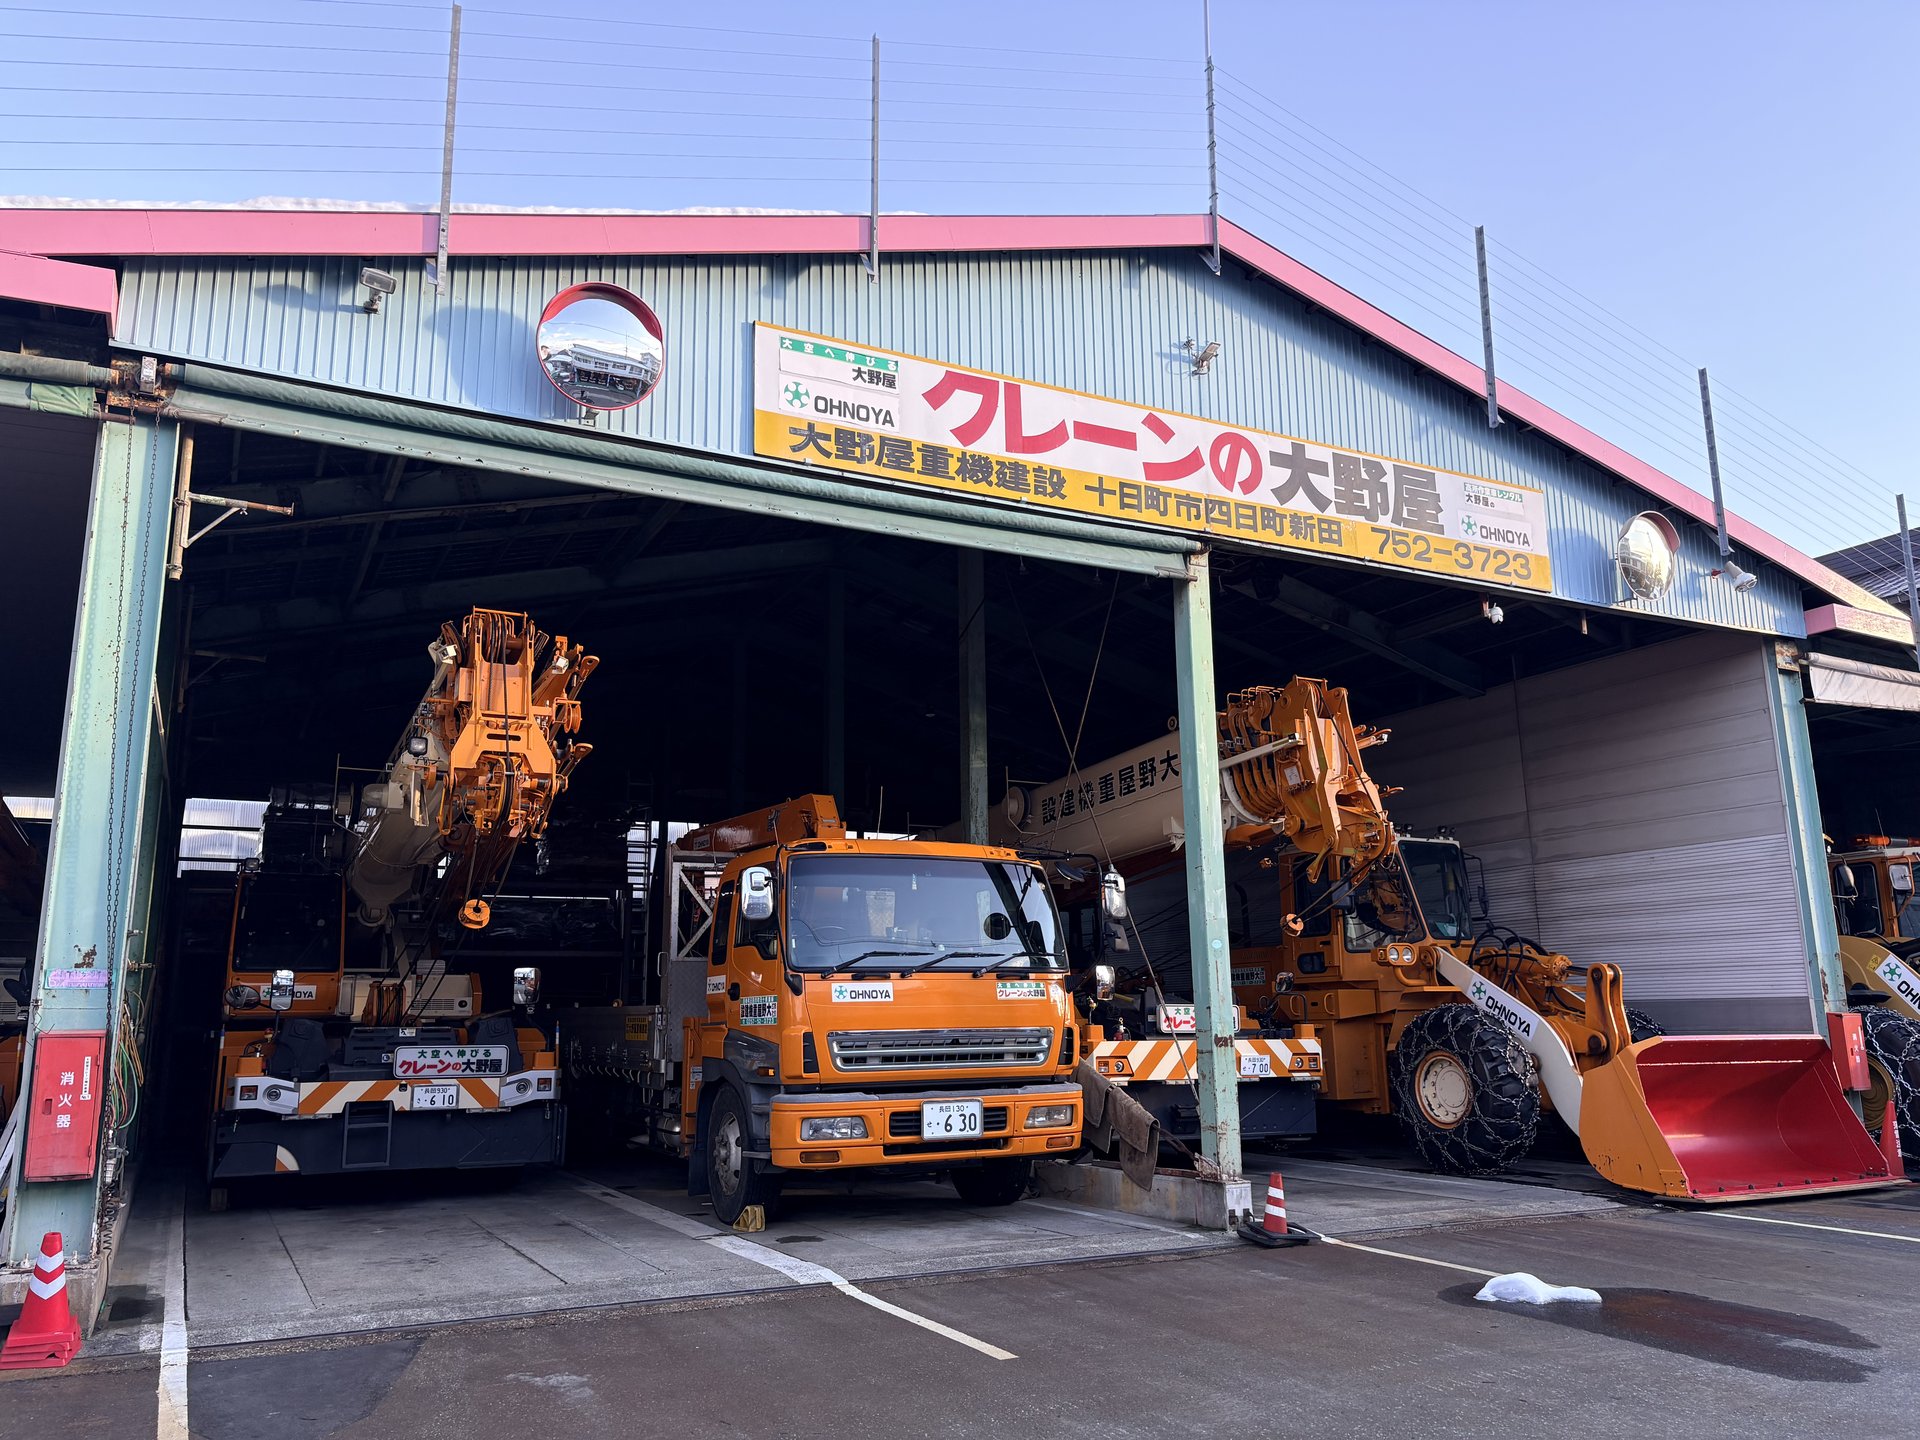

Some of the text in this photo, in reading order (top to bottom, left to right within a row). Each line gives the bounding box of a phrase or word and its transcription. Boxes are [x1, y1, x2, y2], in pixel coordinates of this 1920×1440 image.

[782, 338, 897, 371] 大空へ伸びる
[852, 366, 897, 390] 大野屋
[814, 395, 895, 428] OHNOYA
[922, 369, 1445, 535] クレーンの大野屋
[788, 421, 1533, 581] 大野屋重機建設 十日町市四日町新田 752-3723
[1480, 525, 1531, 547] OHNOYA
[849, 989, 892, 1000] OHNOYA
[1485, 995, 1532, 1037] OHNOYA
[399, 1059, 503, 1075] クレーンの大野屋
[417, 1049, 492, 1059] 大空へ伸びる
[56, 1071, 75, 1128] 消火器
